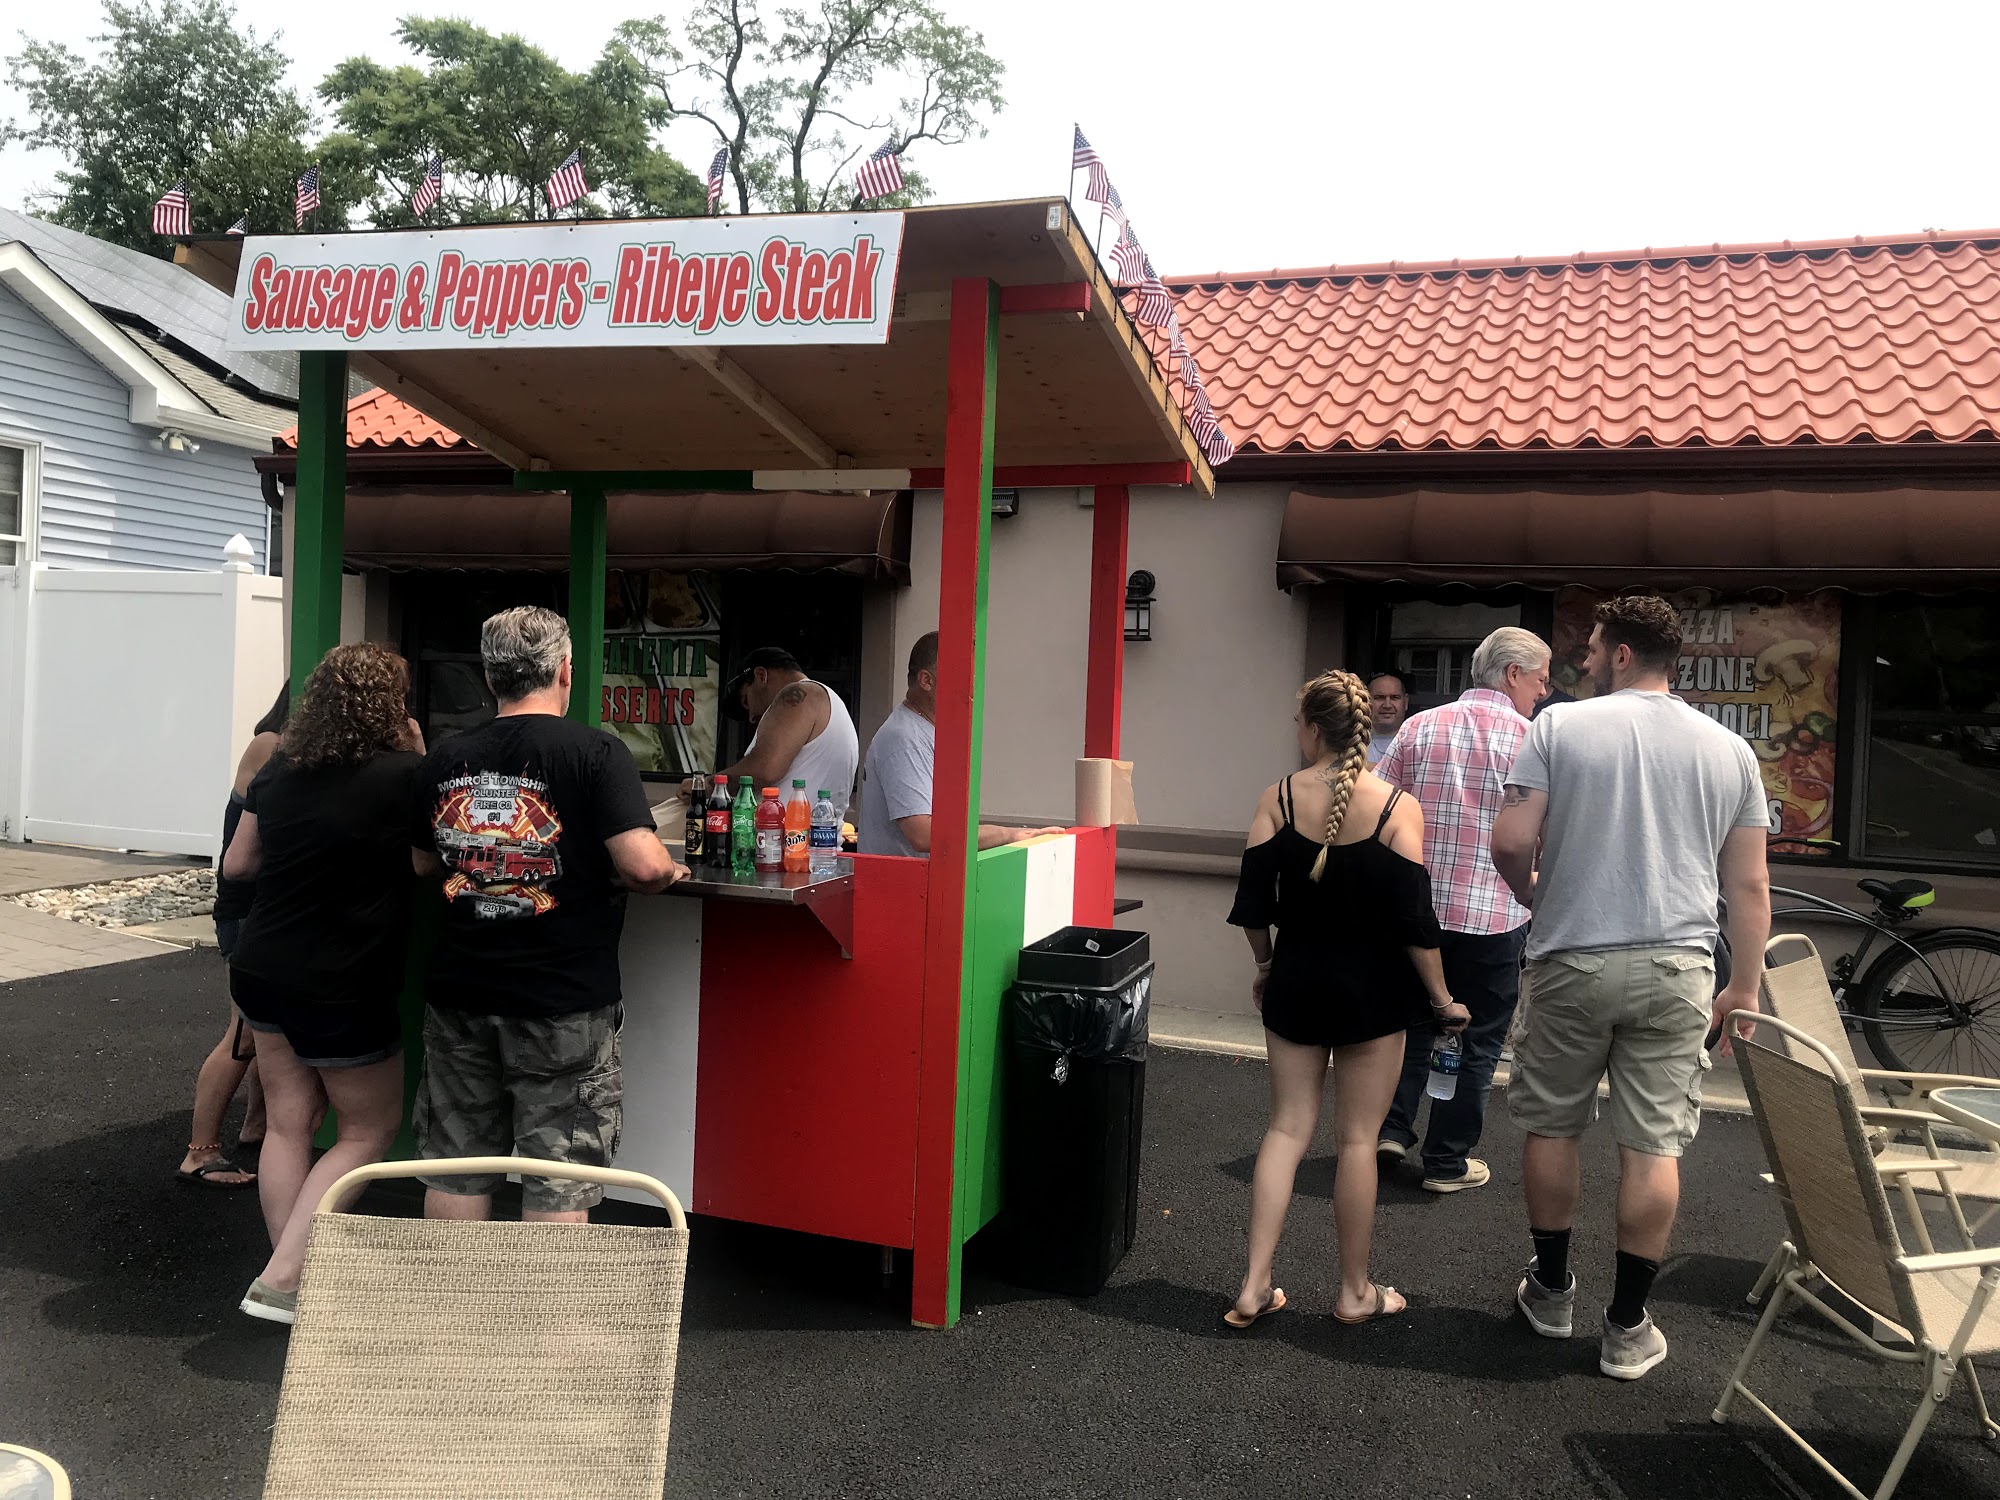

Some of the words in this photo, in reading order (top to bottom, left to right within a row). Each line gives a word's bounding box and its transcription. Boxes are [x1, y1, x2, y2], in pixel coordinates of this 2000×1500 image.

[244, 254, 398, 340] Sausage
[398, 263, 427, 331] &
[610, 243, 752, 333] Ribeye
[754, 236, 882, 324] Steak
[603, 638, 708, 678] ATERIA
[1669, 655, 1757, 692] ZONE
[1690, 702, 1773, 740] OLI
[437, 775, 488, 792] MONROE
[490, 775, 549, 792] TOWNSHIP
[467, 788, 519, 798] VOLUNTEER
[474, 800, 497, 810] FIRE
[487, 812, 501, 821] #1
[813, 832, 836, 840] DASANI
[483, 904, 507, 914] 2018
